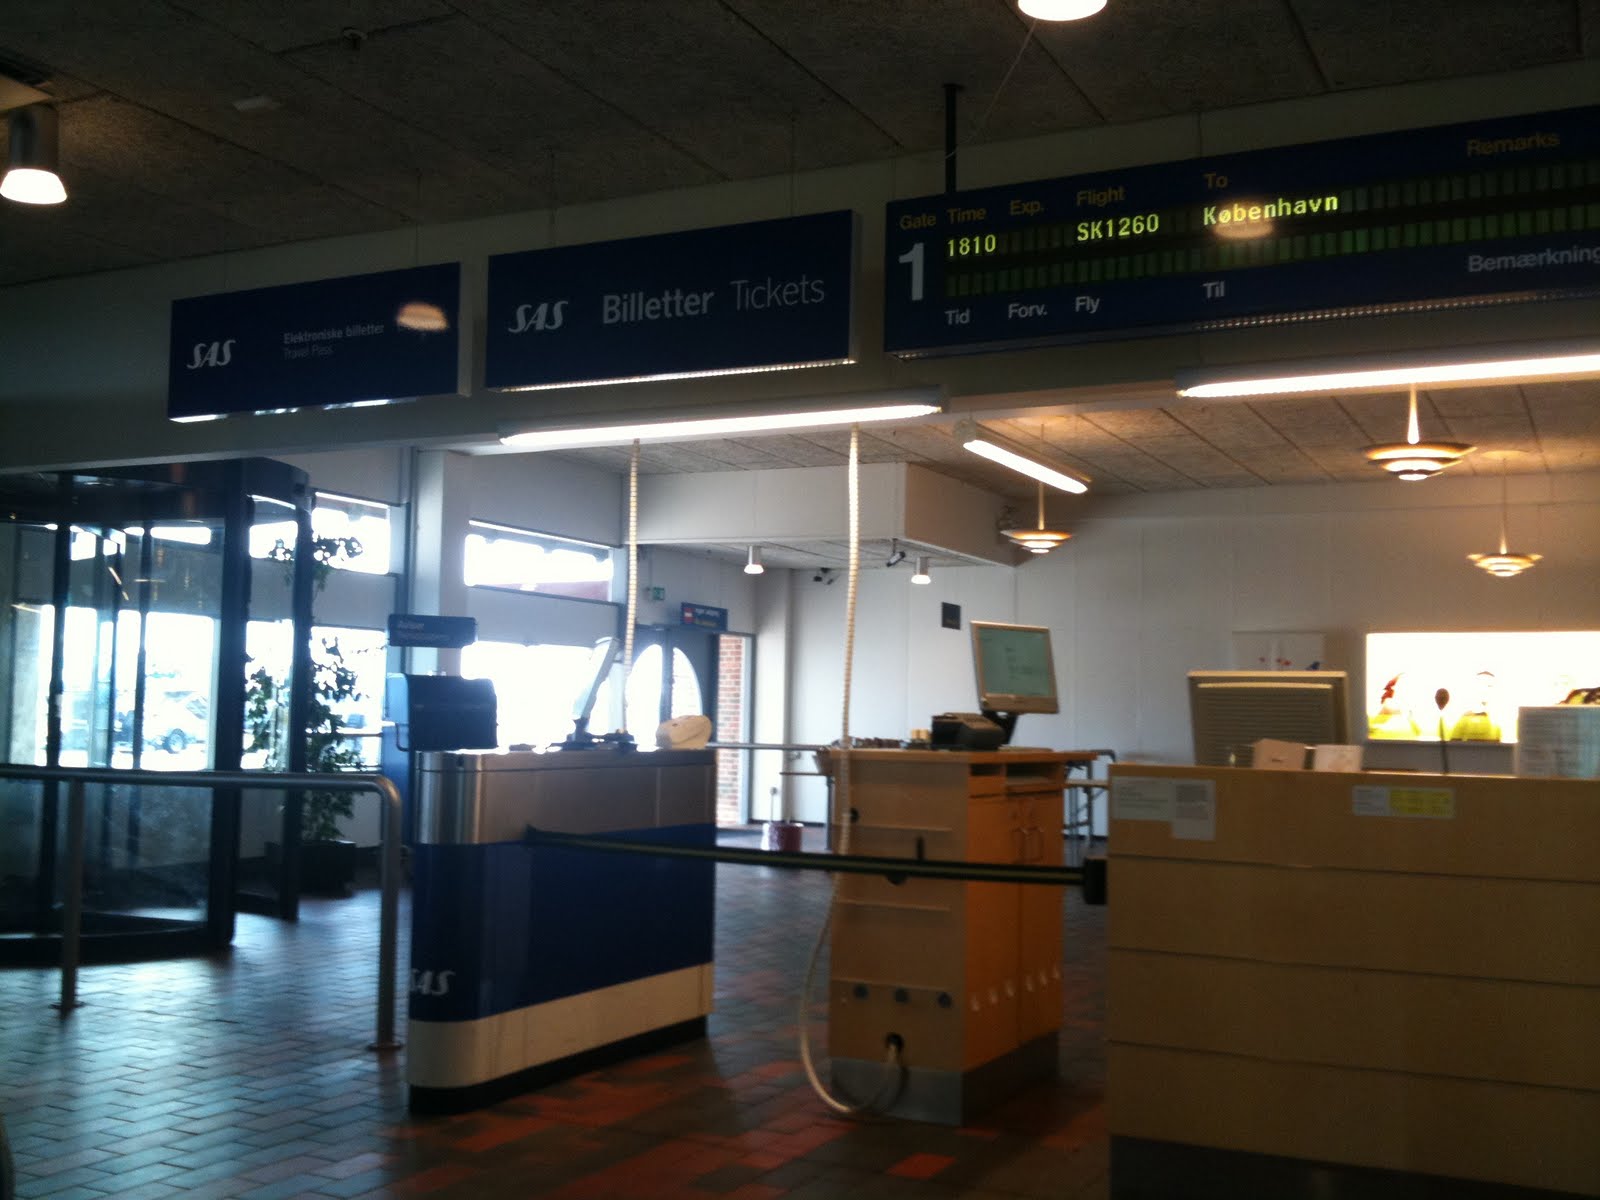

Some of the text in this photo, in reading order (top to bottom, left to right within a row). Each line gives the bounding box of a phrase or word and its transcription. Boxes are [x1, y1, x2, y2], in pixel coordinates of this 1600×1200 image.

[899, 133, 1560, 231] Gate Time Exp. Flight To Remarks
[946, 196, 1339, 257] 1810 SK1260 København
[897, 242, 925, 301] 1
[507, 300, 569, 333] SAS
[602, 274, 826, 325] Billetter Tickets
[945, 308, 971, 326] Tid
[1007, 302, 1048, 320] Forv.
[1074, 295, 1101, 315] Fly
[1202, 281, 1226, 299] Til
[186, 339, 236, 369] SAS
[283, 323, 385, 345] Elektroniske billetter
